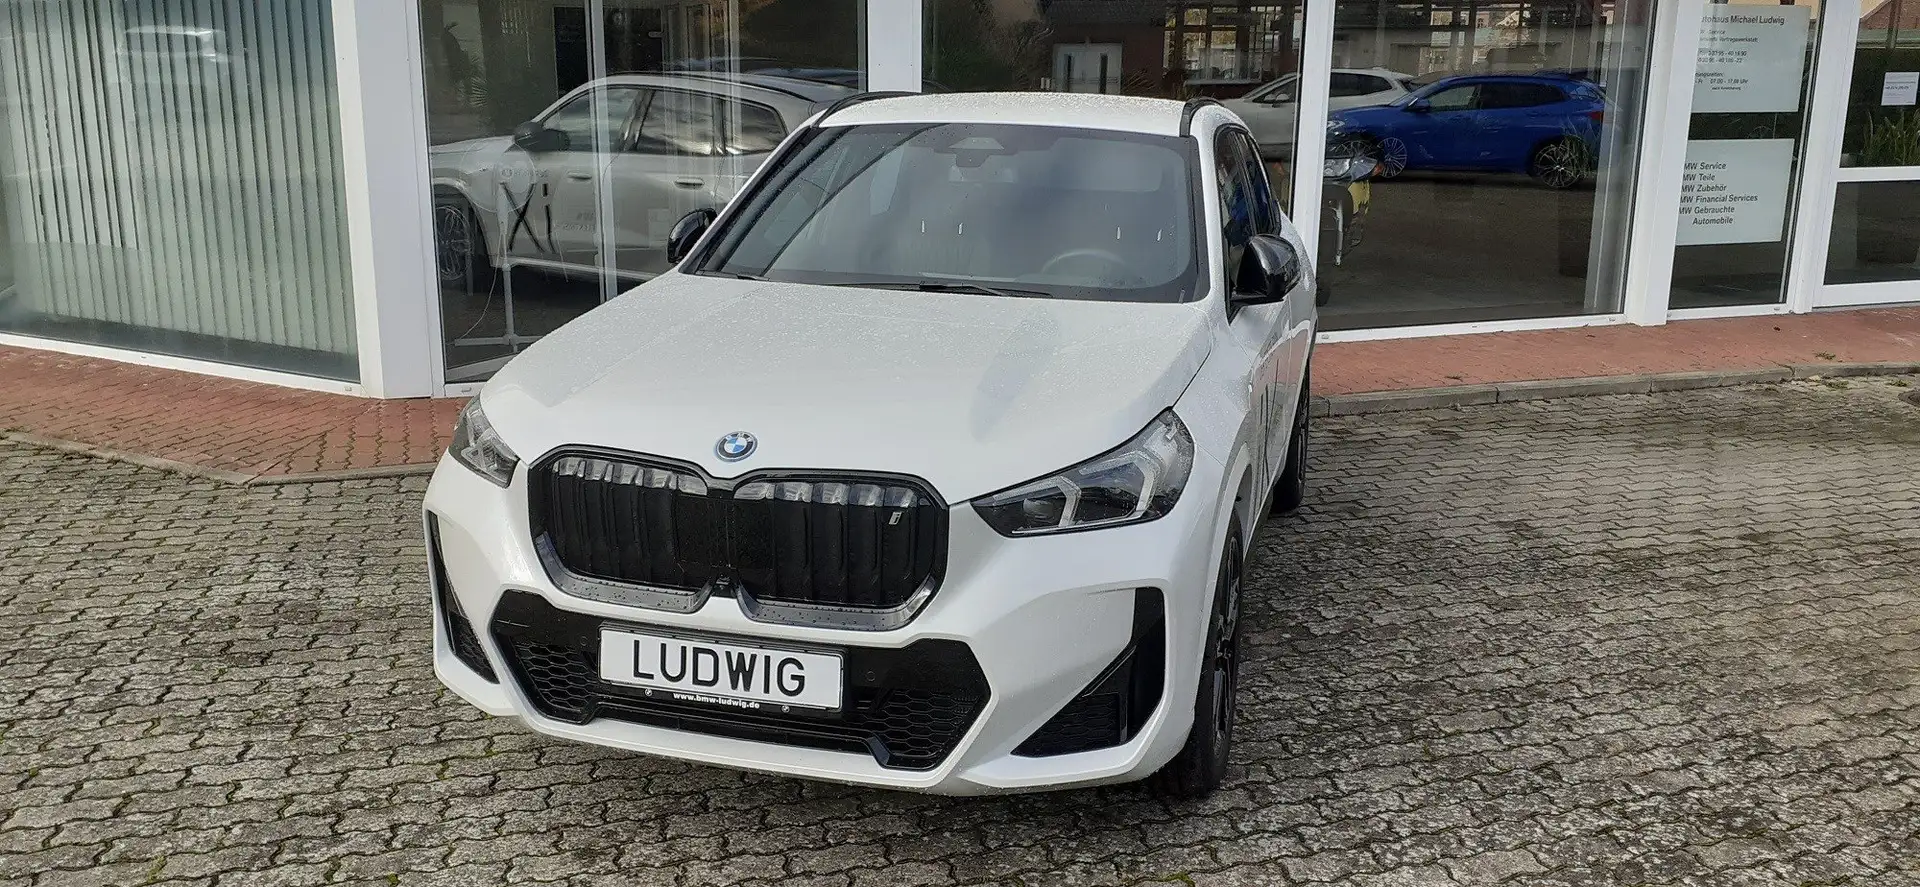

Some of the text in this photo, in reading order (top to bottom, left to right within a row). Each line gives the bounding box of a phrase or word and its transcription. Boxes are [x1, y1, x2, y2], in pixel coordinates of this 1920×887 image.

[1730, 15, 1758, 24] Michael
[1760, 15, 1785, 26] Ludwig
[1684, 162, 1727, 170] MW Service
[1699, 173, 1715, 181] Teile
[1681, 184, 1727, 192] MW Zubehör
[1695, 195, 1727, 203] Financial
[1728, 194, 1758, 202] Services
[1694, 205, 1735, 214] Gebrauchte
[1692, 216, 1734, 225] Automobile
[633, 639, 806, 697] LUDWIG
[673, 691, 760, 710] www.bmw-ludwig.de
